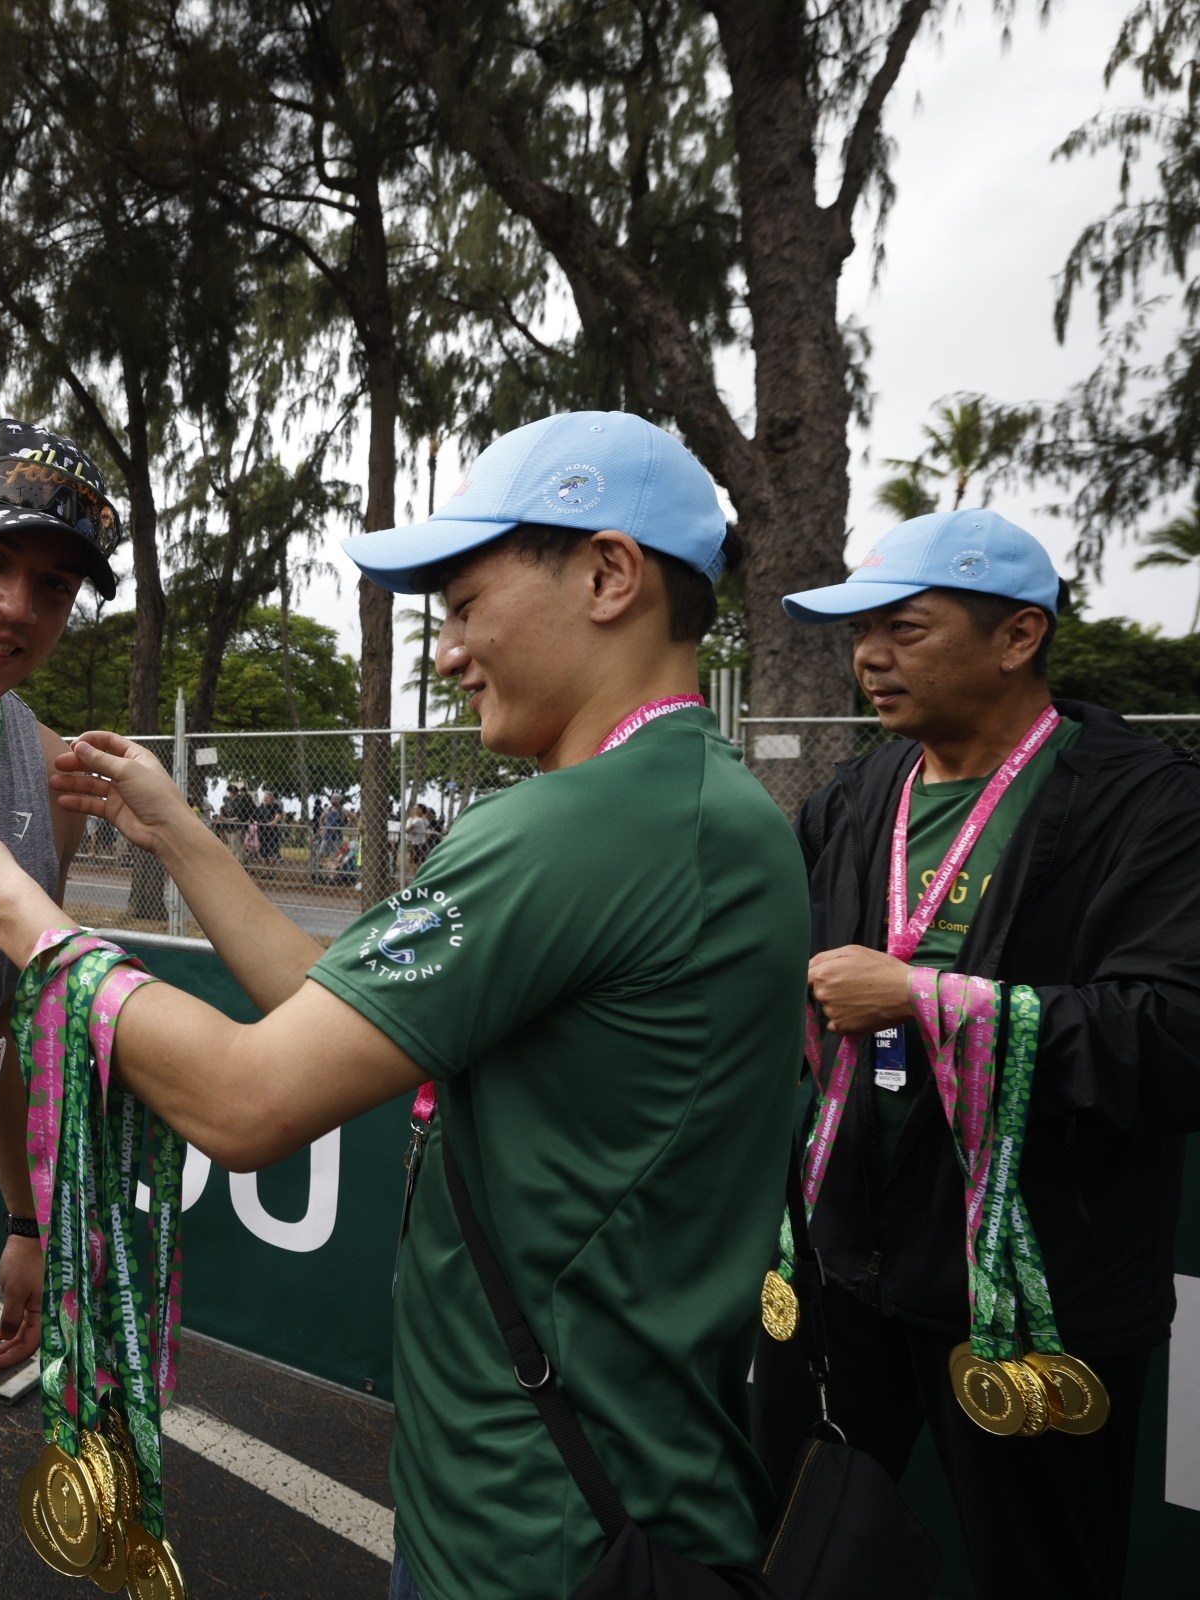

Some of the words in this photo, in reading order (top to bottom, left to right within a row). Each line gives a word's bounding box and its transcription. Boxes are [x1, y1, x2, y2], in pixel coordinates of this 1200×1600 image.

[547, 471, 563, 486] JAL
[565, 463, 606, 493] HONOLULU
[542, 488, 580, 515] MARATHON
[1021, 717, 1053, 752] HONOLULU
[917, 869, 993, 904] SG
[920, 904, 932, 919] JAL
[927, 864, 954, 904] HONOLULU
[949, 823, 978, 865] MARATHON
[387, 887, 463, 948] HONOLULU
[876, 1040, 891, 1048] LINE
[121, 1092, 135, 1172] MARATHON
[821, 1097, 839, 1140] MARATHON
[810, 1139, 826, 1179] HONOLULU
[999, 1135, 1014, 1194] MARATHON
[806, 1180, 815, 1195] JAL
[60, 1180, 73, 1259] MARATHON
[986, 1194, 1004, 1251] HONOLULU
[110, 1202, 131, 1286] MARATHON
[159, 1202, 171, 1288] MARATHON
[983, 1251, 995, 1273] JAL
[1018, 1235, 1031, 1258] JAL
[120, 1290, 142, 1371] HONOLULU
[131, 1375, 146, 1404] JAL
